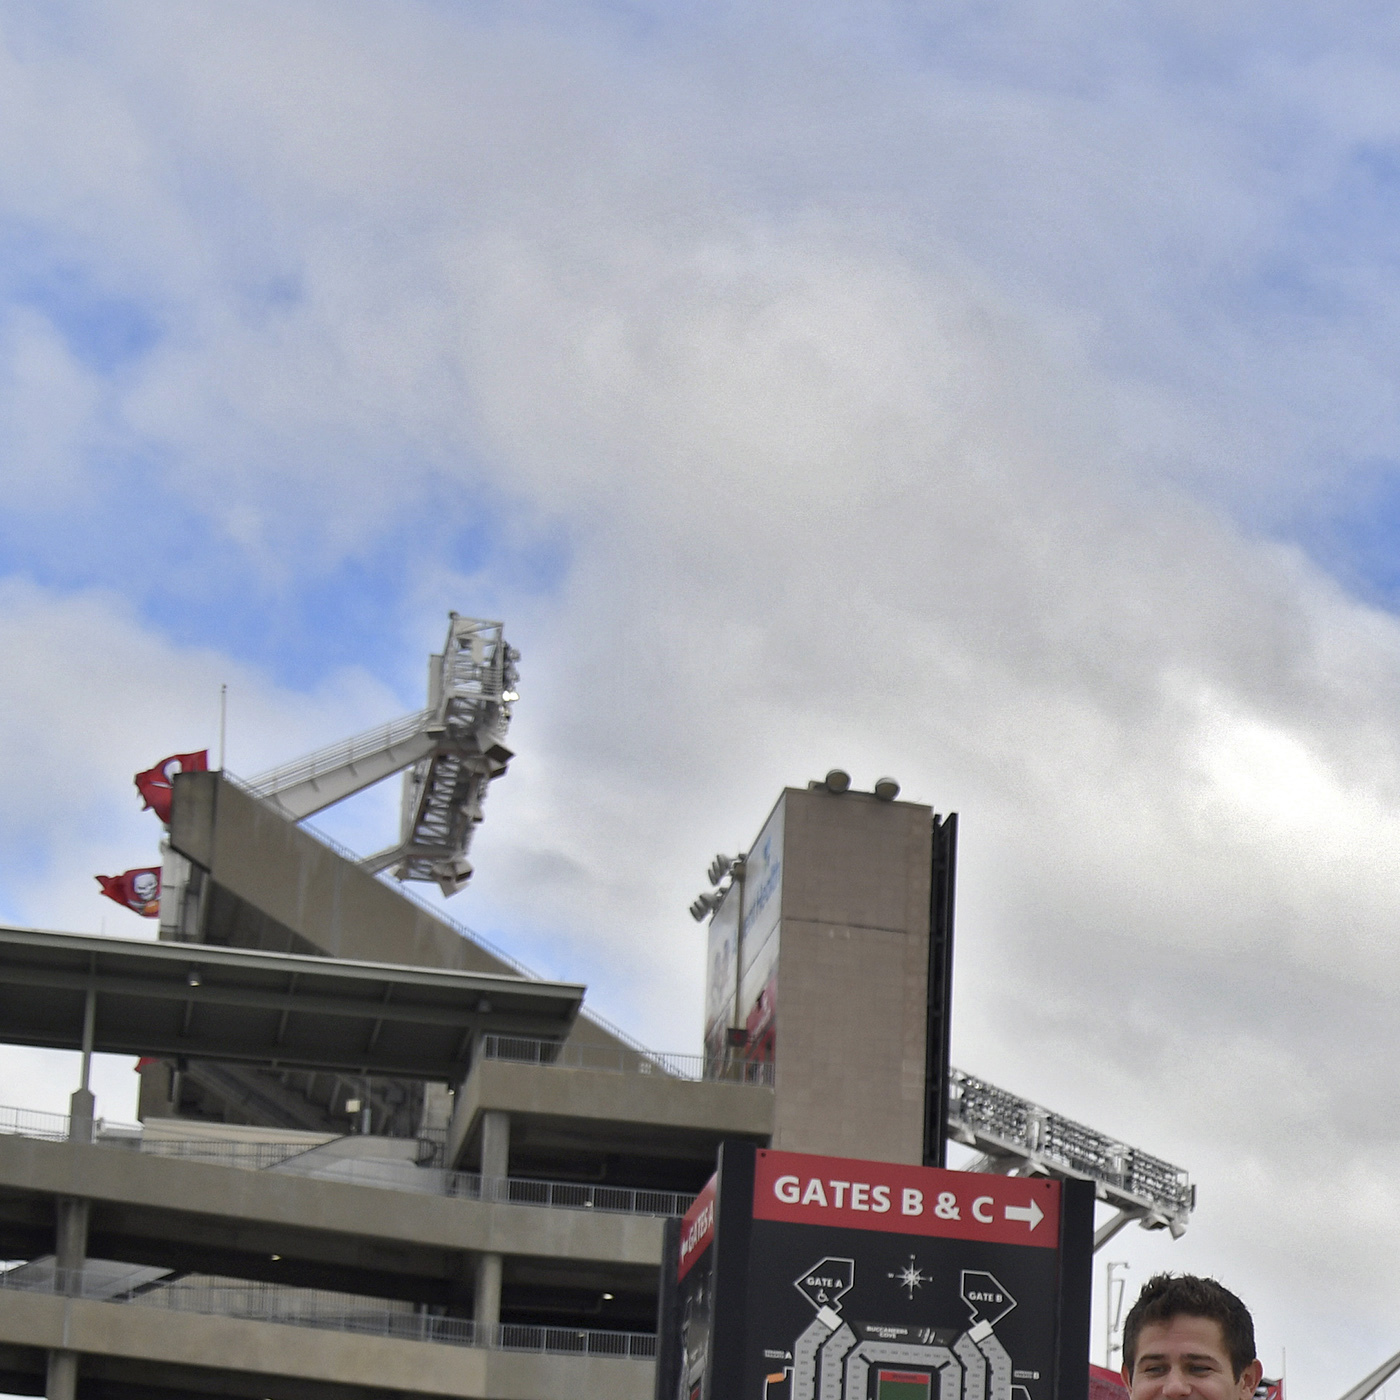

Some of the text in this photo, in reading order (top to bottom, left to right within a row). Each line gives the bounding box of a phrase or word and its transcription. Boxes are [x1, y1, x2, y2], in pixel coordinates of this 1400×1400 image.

[775, 1176, 994, 1223] GATES B & C
[806, 1277, 843, 1288] GATE A
[969, 1292, 1002, 1303] GATE B
